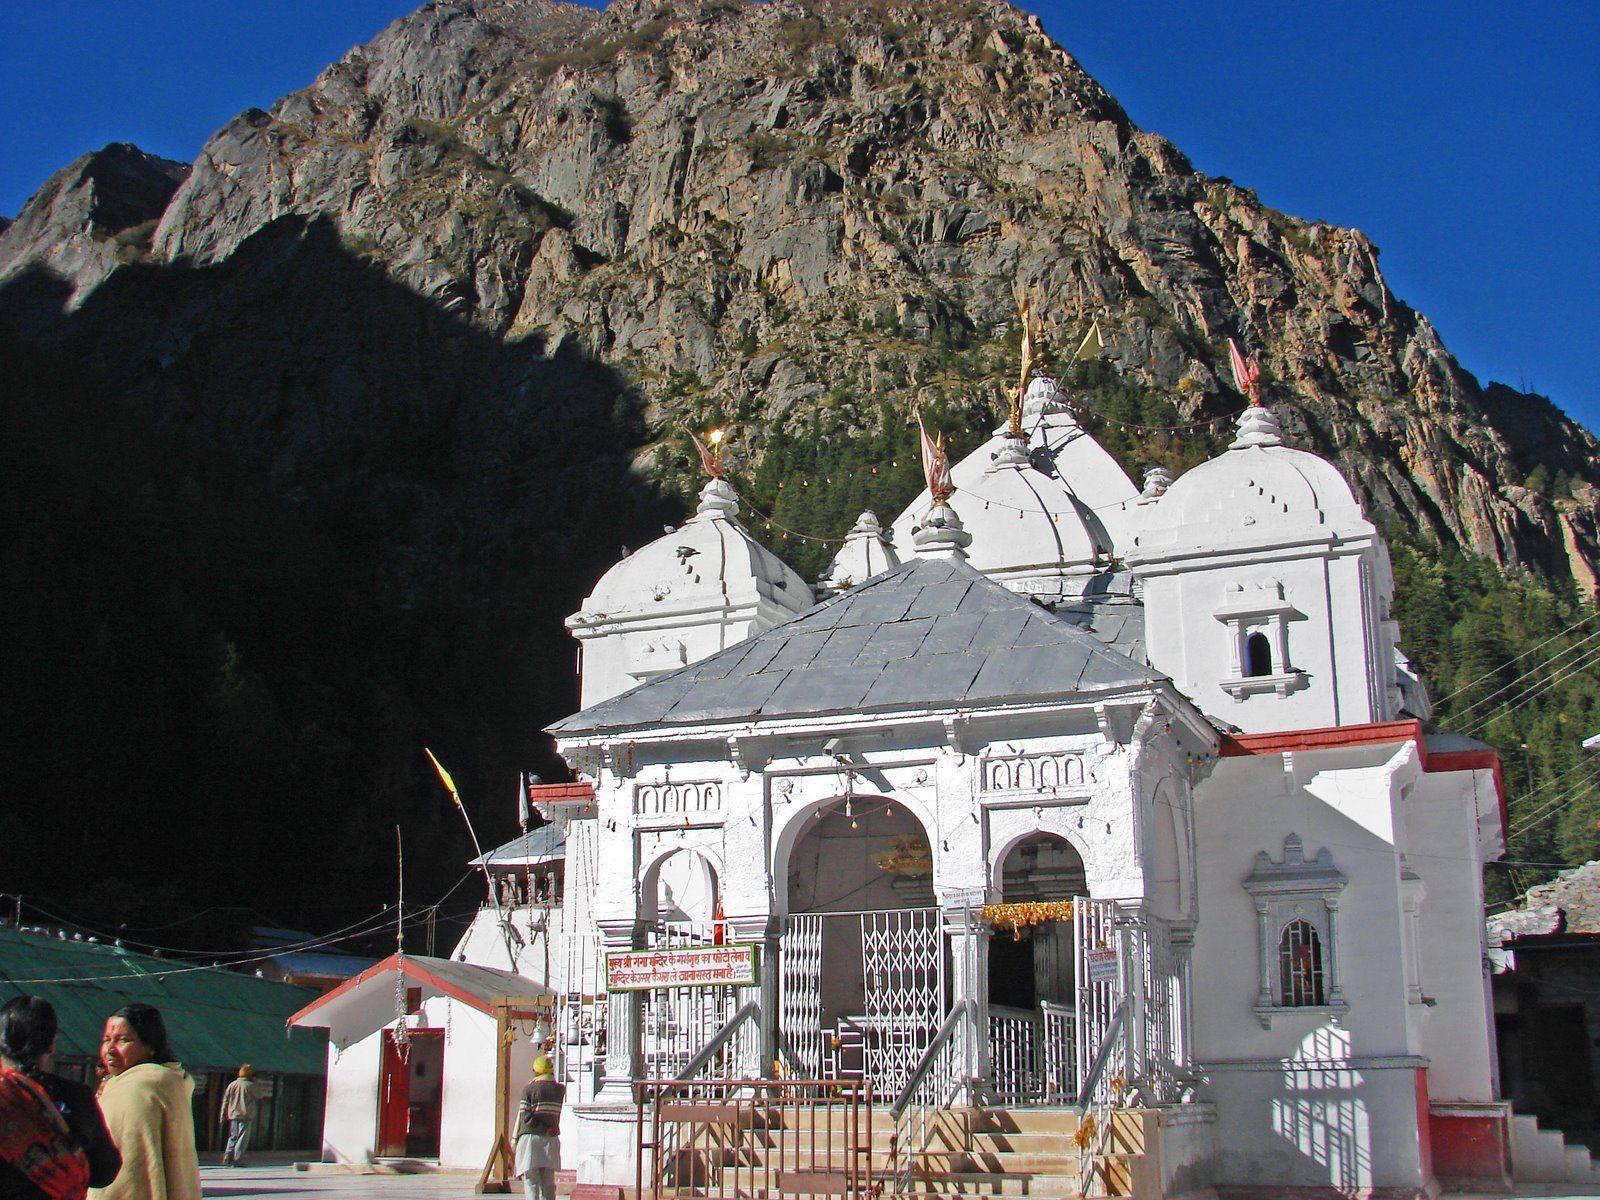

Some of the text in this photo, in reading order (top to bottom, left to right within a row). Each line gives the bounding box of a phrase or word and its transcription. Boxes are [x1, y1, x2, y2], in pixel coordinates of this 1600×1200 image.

[624, 955, 632, 968] श्री
[634, 956, 648, 967] गंगा
[649, 953, 668, 968] मन्दिर
[668, 952, 676, 965] के
[700, 953, 711, 964] का
[712, 949, 730, 963] फोटो
[730, 948, 745, 963] लेना
[744, 950, 751, 962] व
[610, 970, 630, 984] मन्दिर
[629, 969, 637, 982] के
[670, 968, 678, 983] ले
[678, 970, 696, 983] जाना
[713, 968, 726, 979] मना
